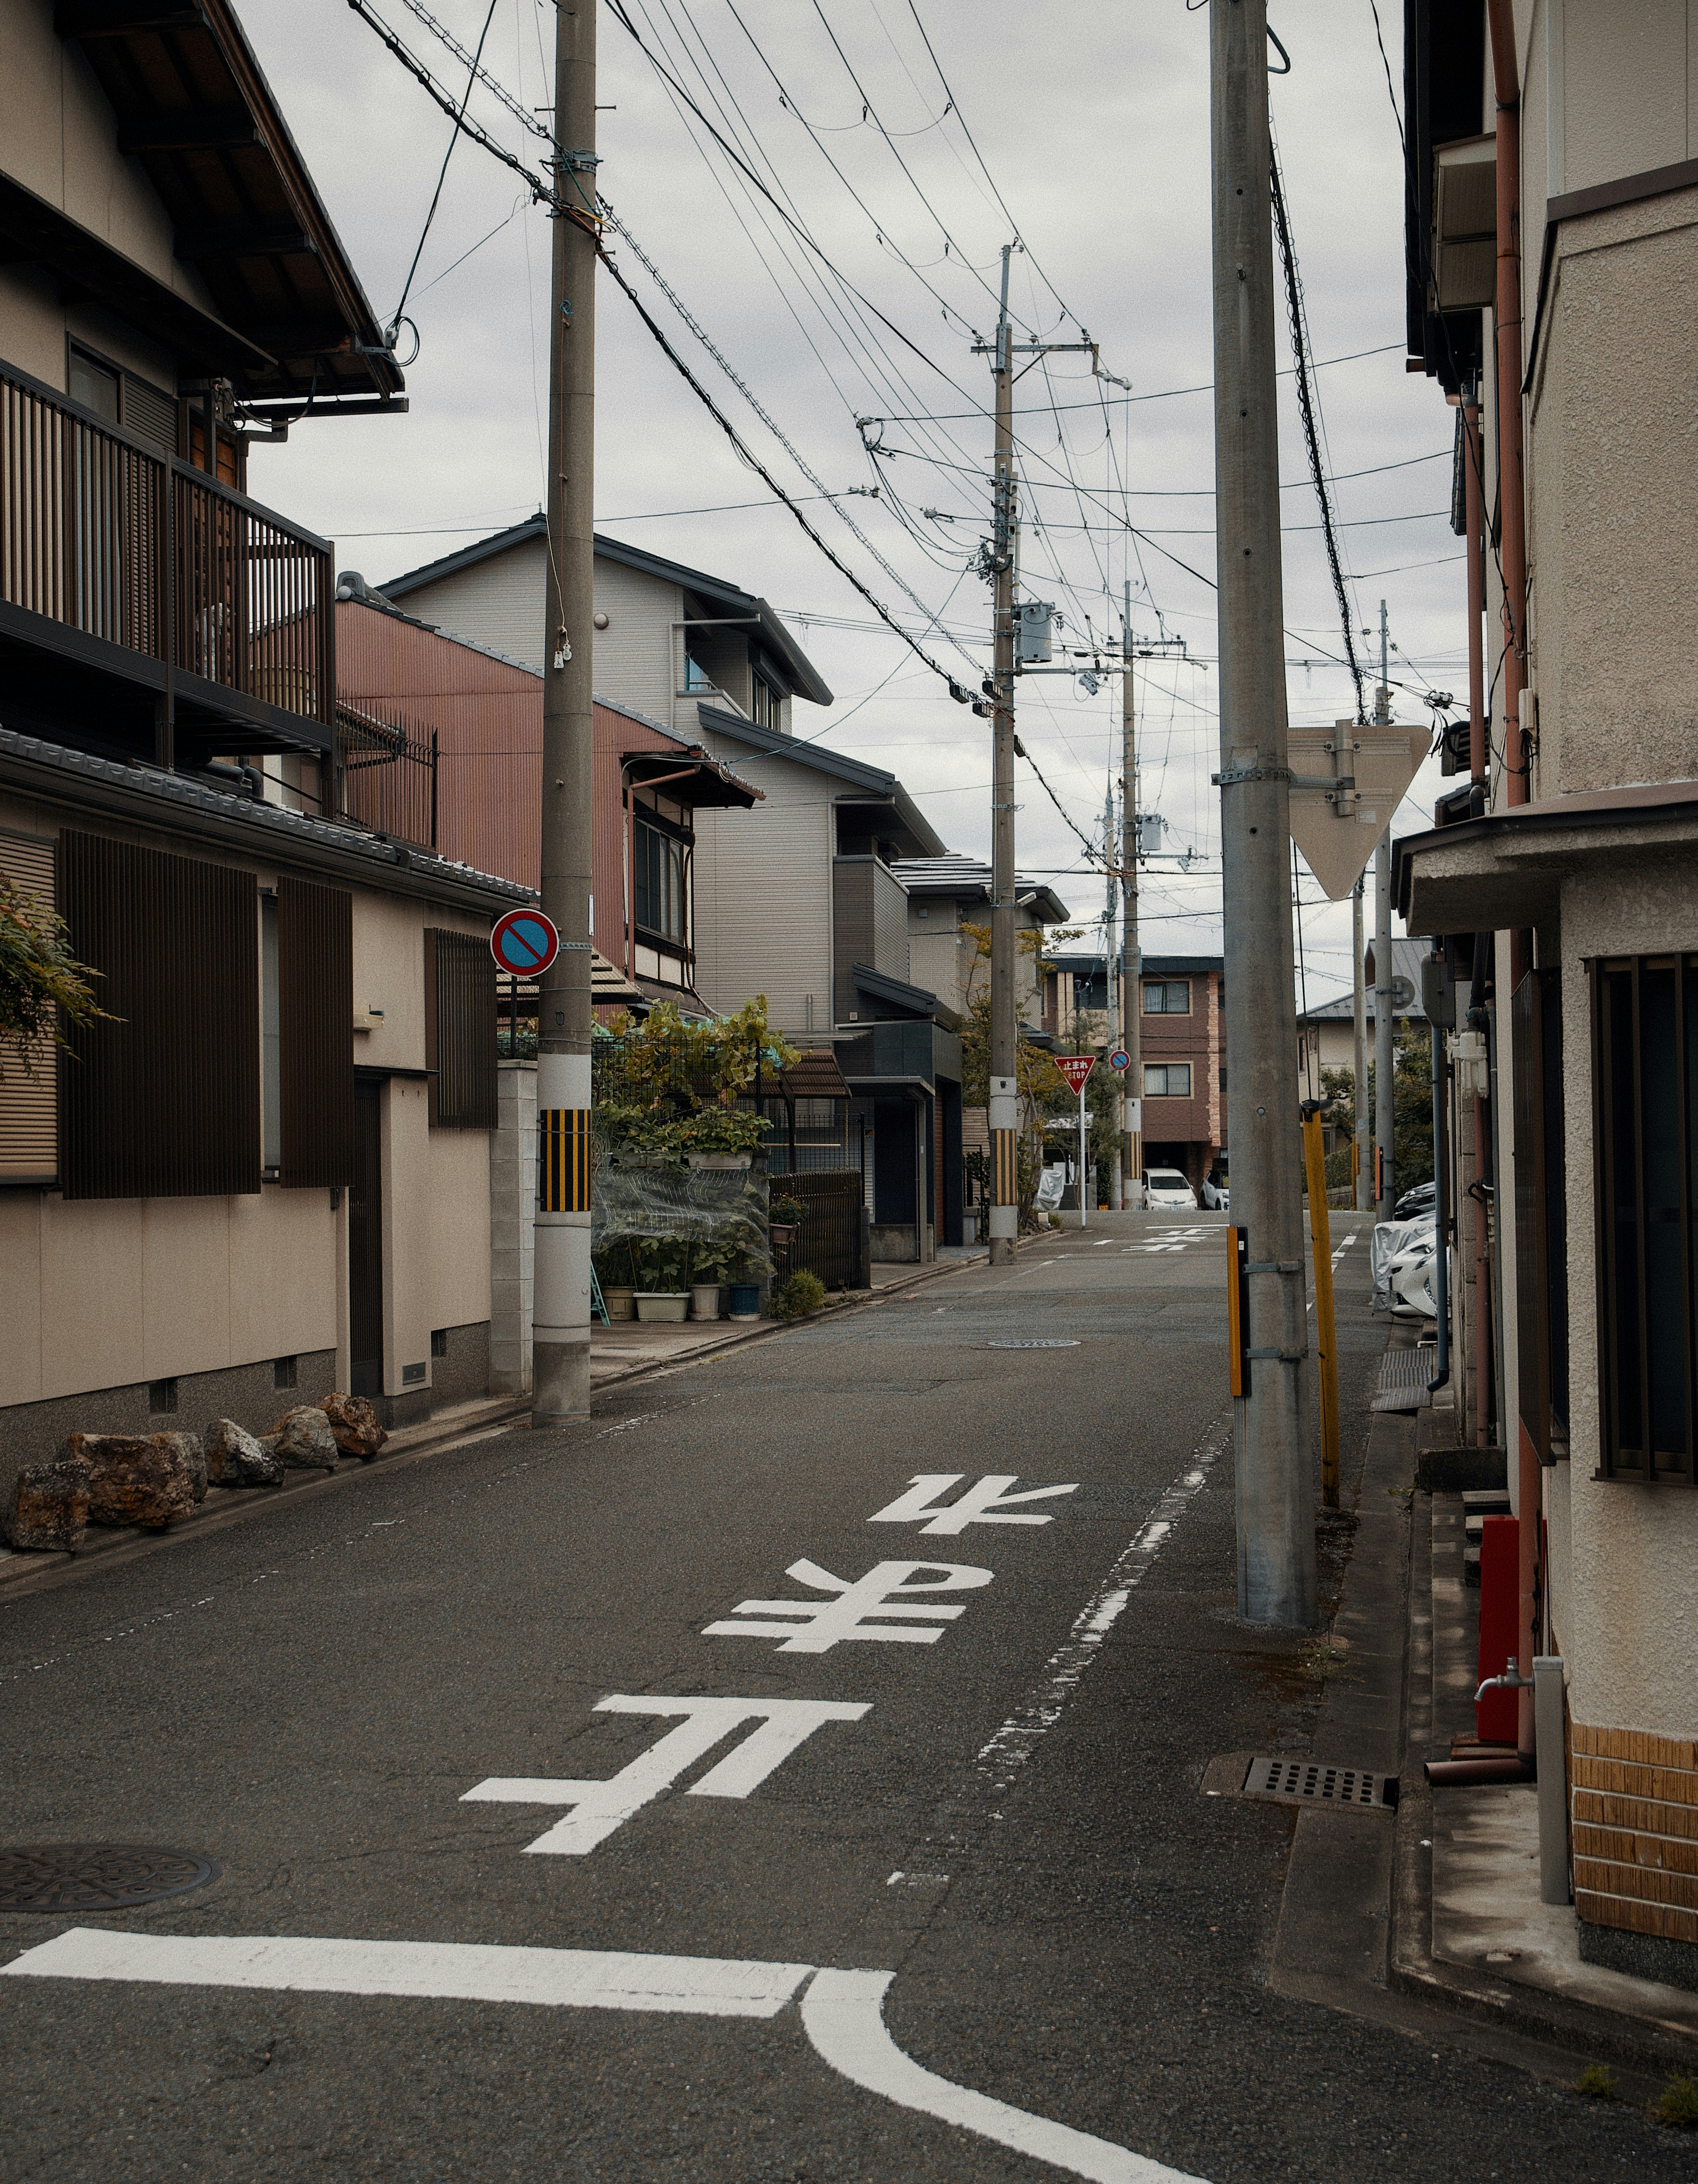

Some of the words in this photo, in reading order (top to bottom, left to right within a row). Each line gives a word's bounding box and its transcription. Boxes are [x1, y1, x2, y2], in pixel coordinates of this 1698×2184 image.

[1064, 1061, 1088, 1070] 止まれ
[458, 1473, 1080, 1856] 止まれ
